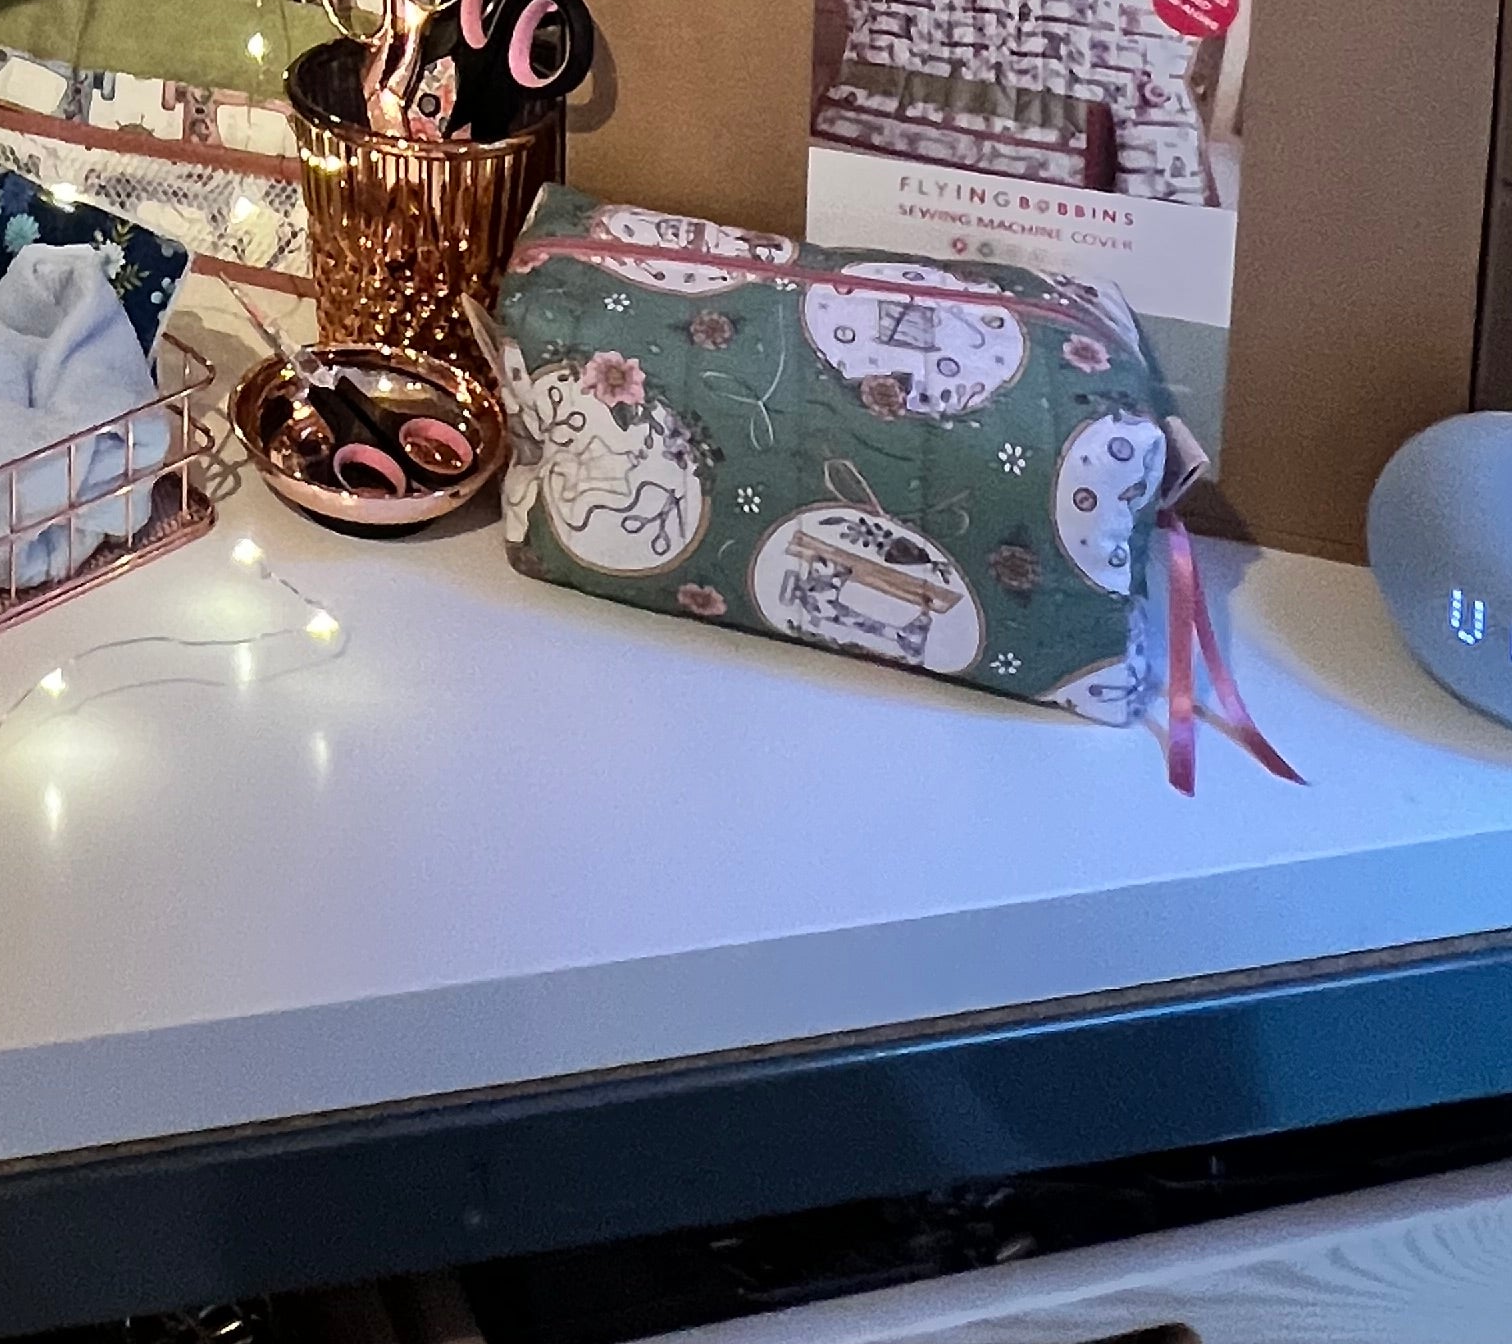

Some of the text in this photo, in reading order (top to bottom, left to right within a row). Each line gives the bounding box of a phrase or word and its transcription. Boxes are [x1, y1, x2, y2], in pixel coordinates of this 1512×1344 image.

[898, 203, 1134, 251] SEWING MACHINE COVER
